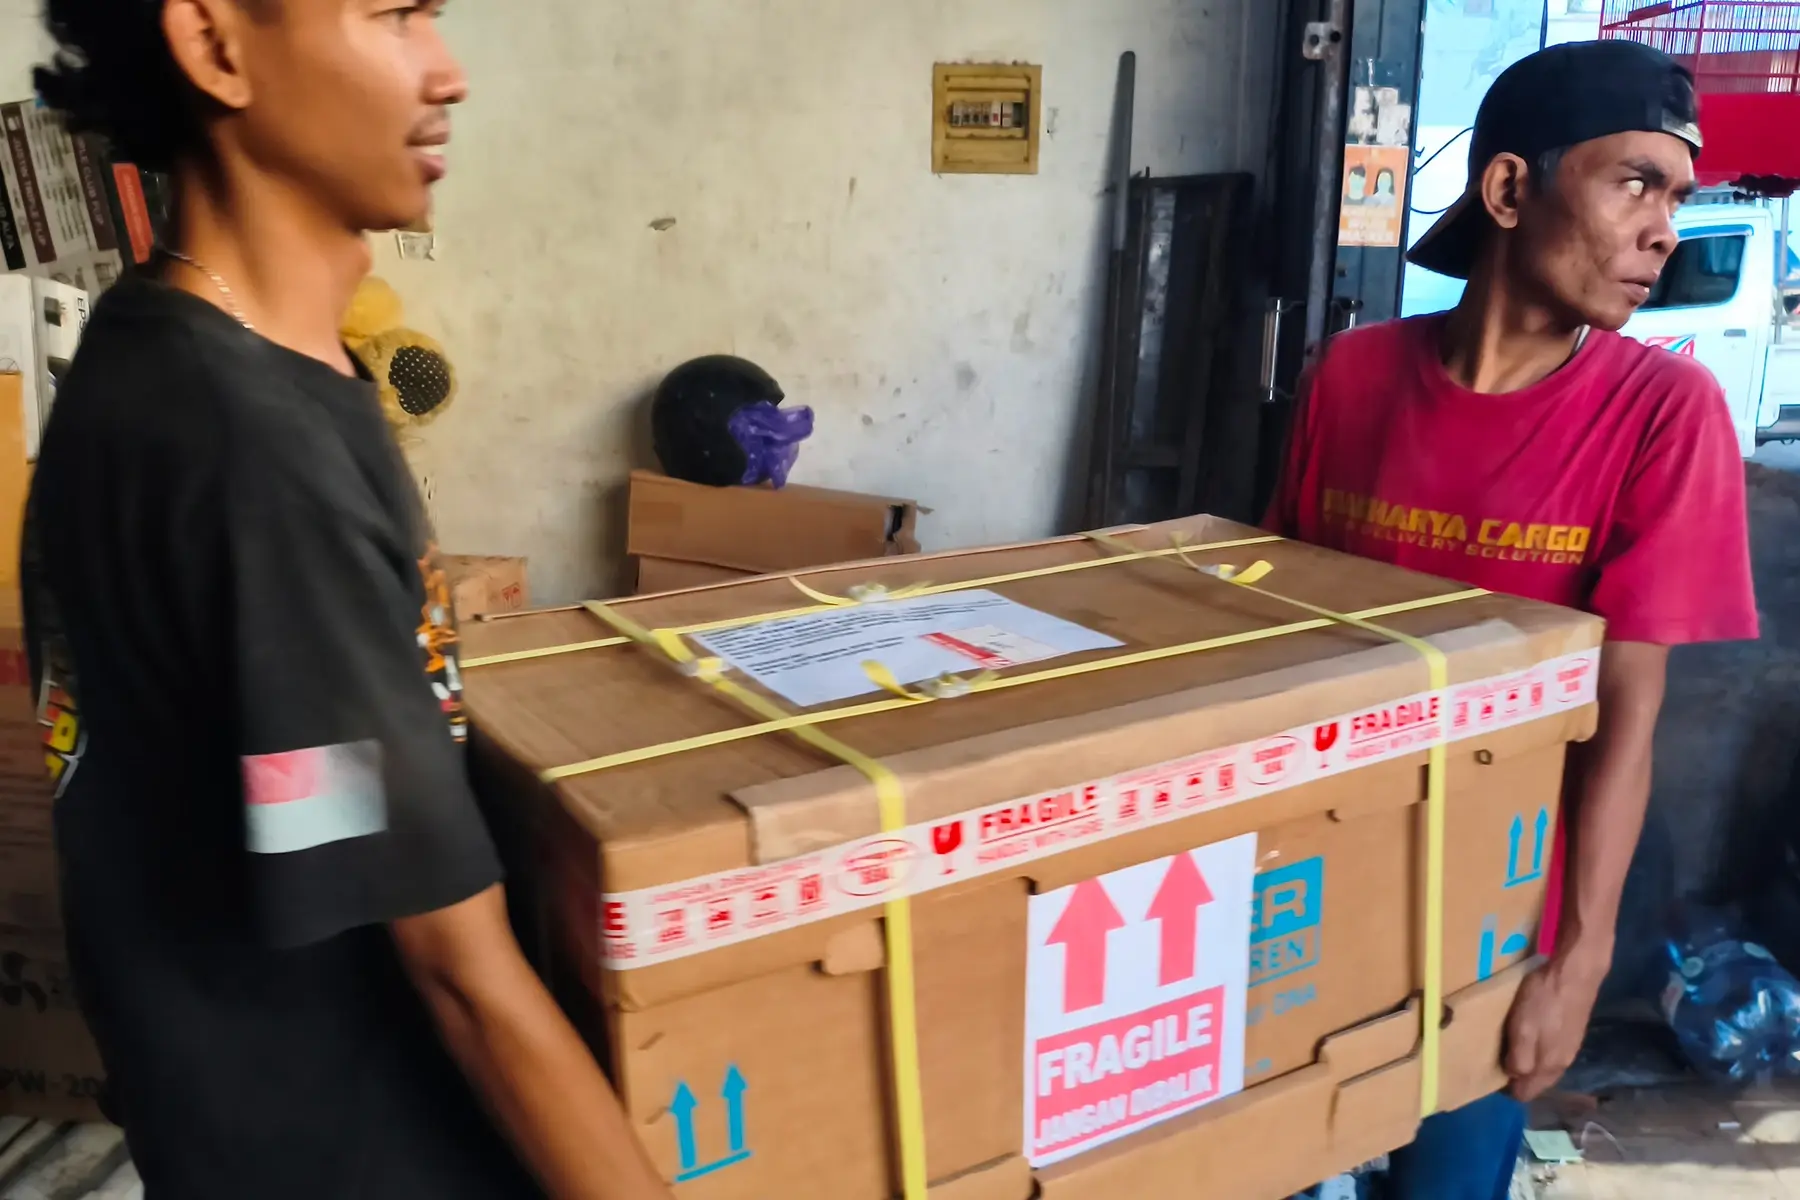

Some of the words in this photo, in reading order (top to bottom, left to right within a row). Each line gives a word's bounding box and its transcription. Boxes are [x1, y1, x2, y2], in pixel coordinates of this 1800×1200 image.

[1465, 543, 1584, 565] SOLUTION
[1477, 518, 1591, 552] CARGO
[1350, 696, 1441, 739] FRAGILE
[979, 785, 1098, 839] FRAGILE
[1038, 1003, 1213, 1097] FRAGILE
[1035, 1093, 1128, 1148] JANGAN
